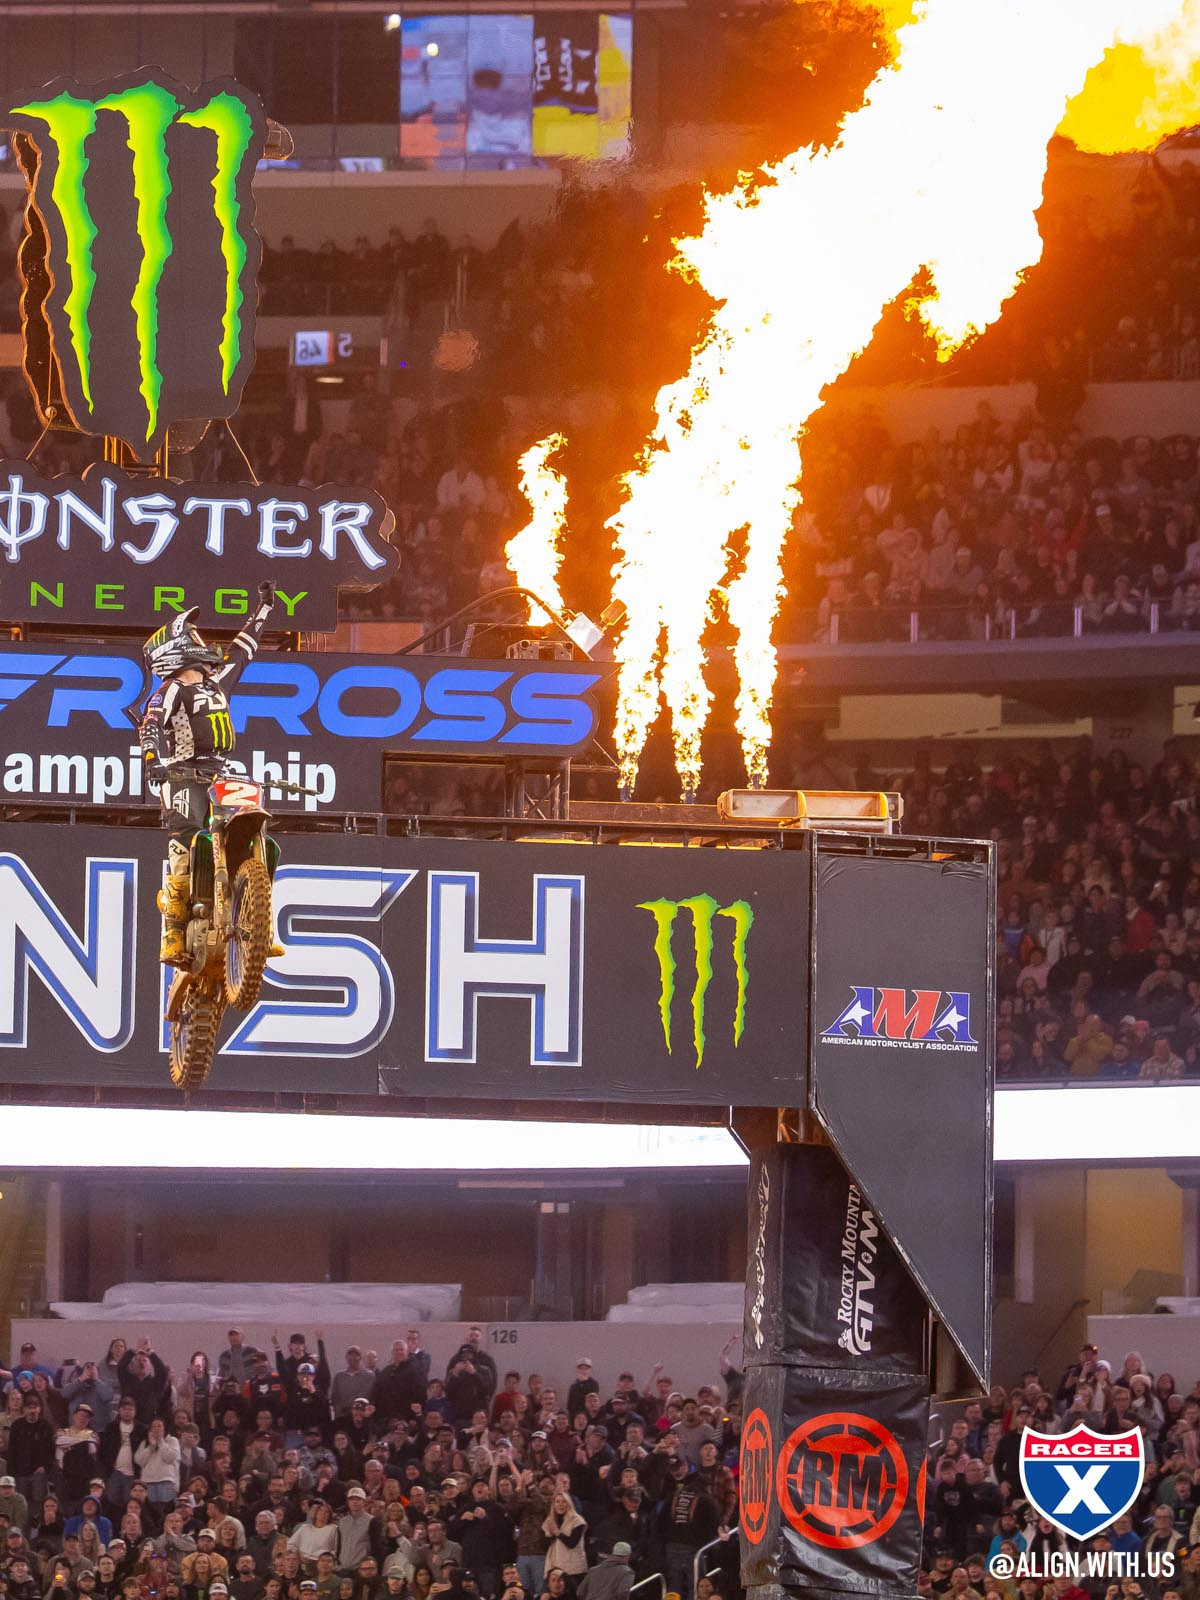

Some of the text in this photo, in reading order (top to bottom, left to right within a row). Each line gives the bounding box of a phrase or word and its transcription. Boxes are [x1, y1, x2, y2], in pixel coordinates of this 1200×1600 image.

[221, 782, 260, 807] 2
[819, 986, 979, 1043] AMA
[821, 1037, 978, 1052] AMERICAN MOTORCYCLIST ASSOCIATION
[837, 1260, 855, 1324] ROCKY
[491, 1329, 518, 1344] 126
[803, 1450, 882, 1512] RM
